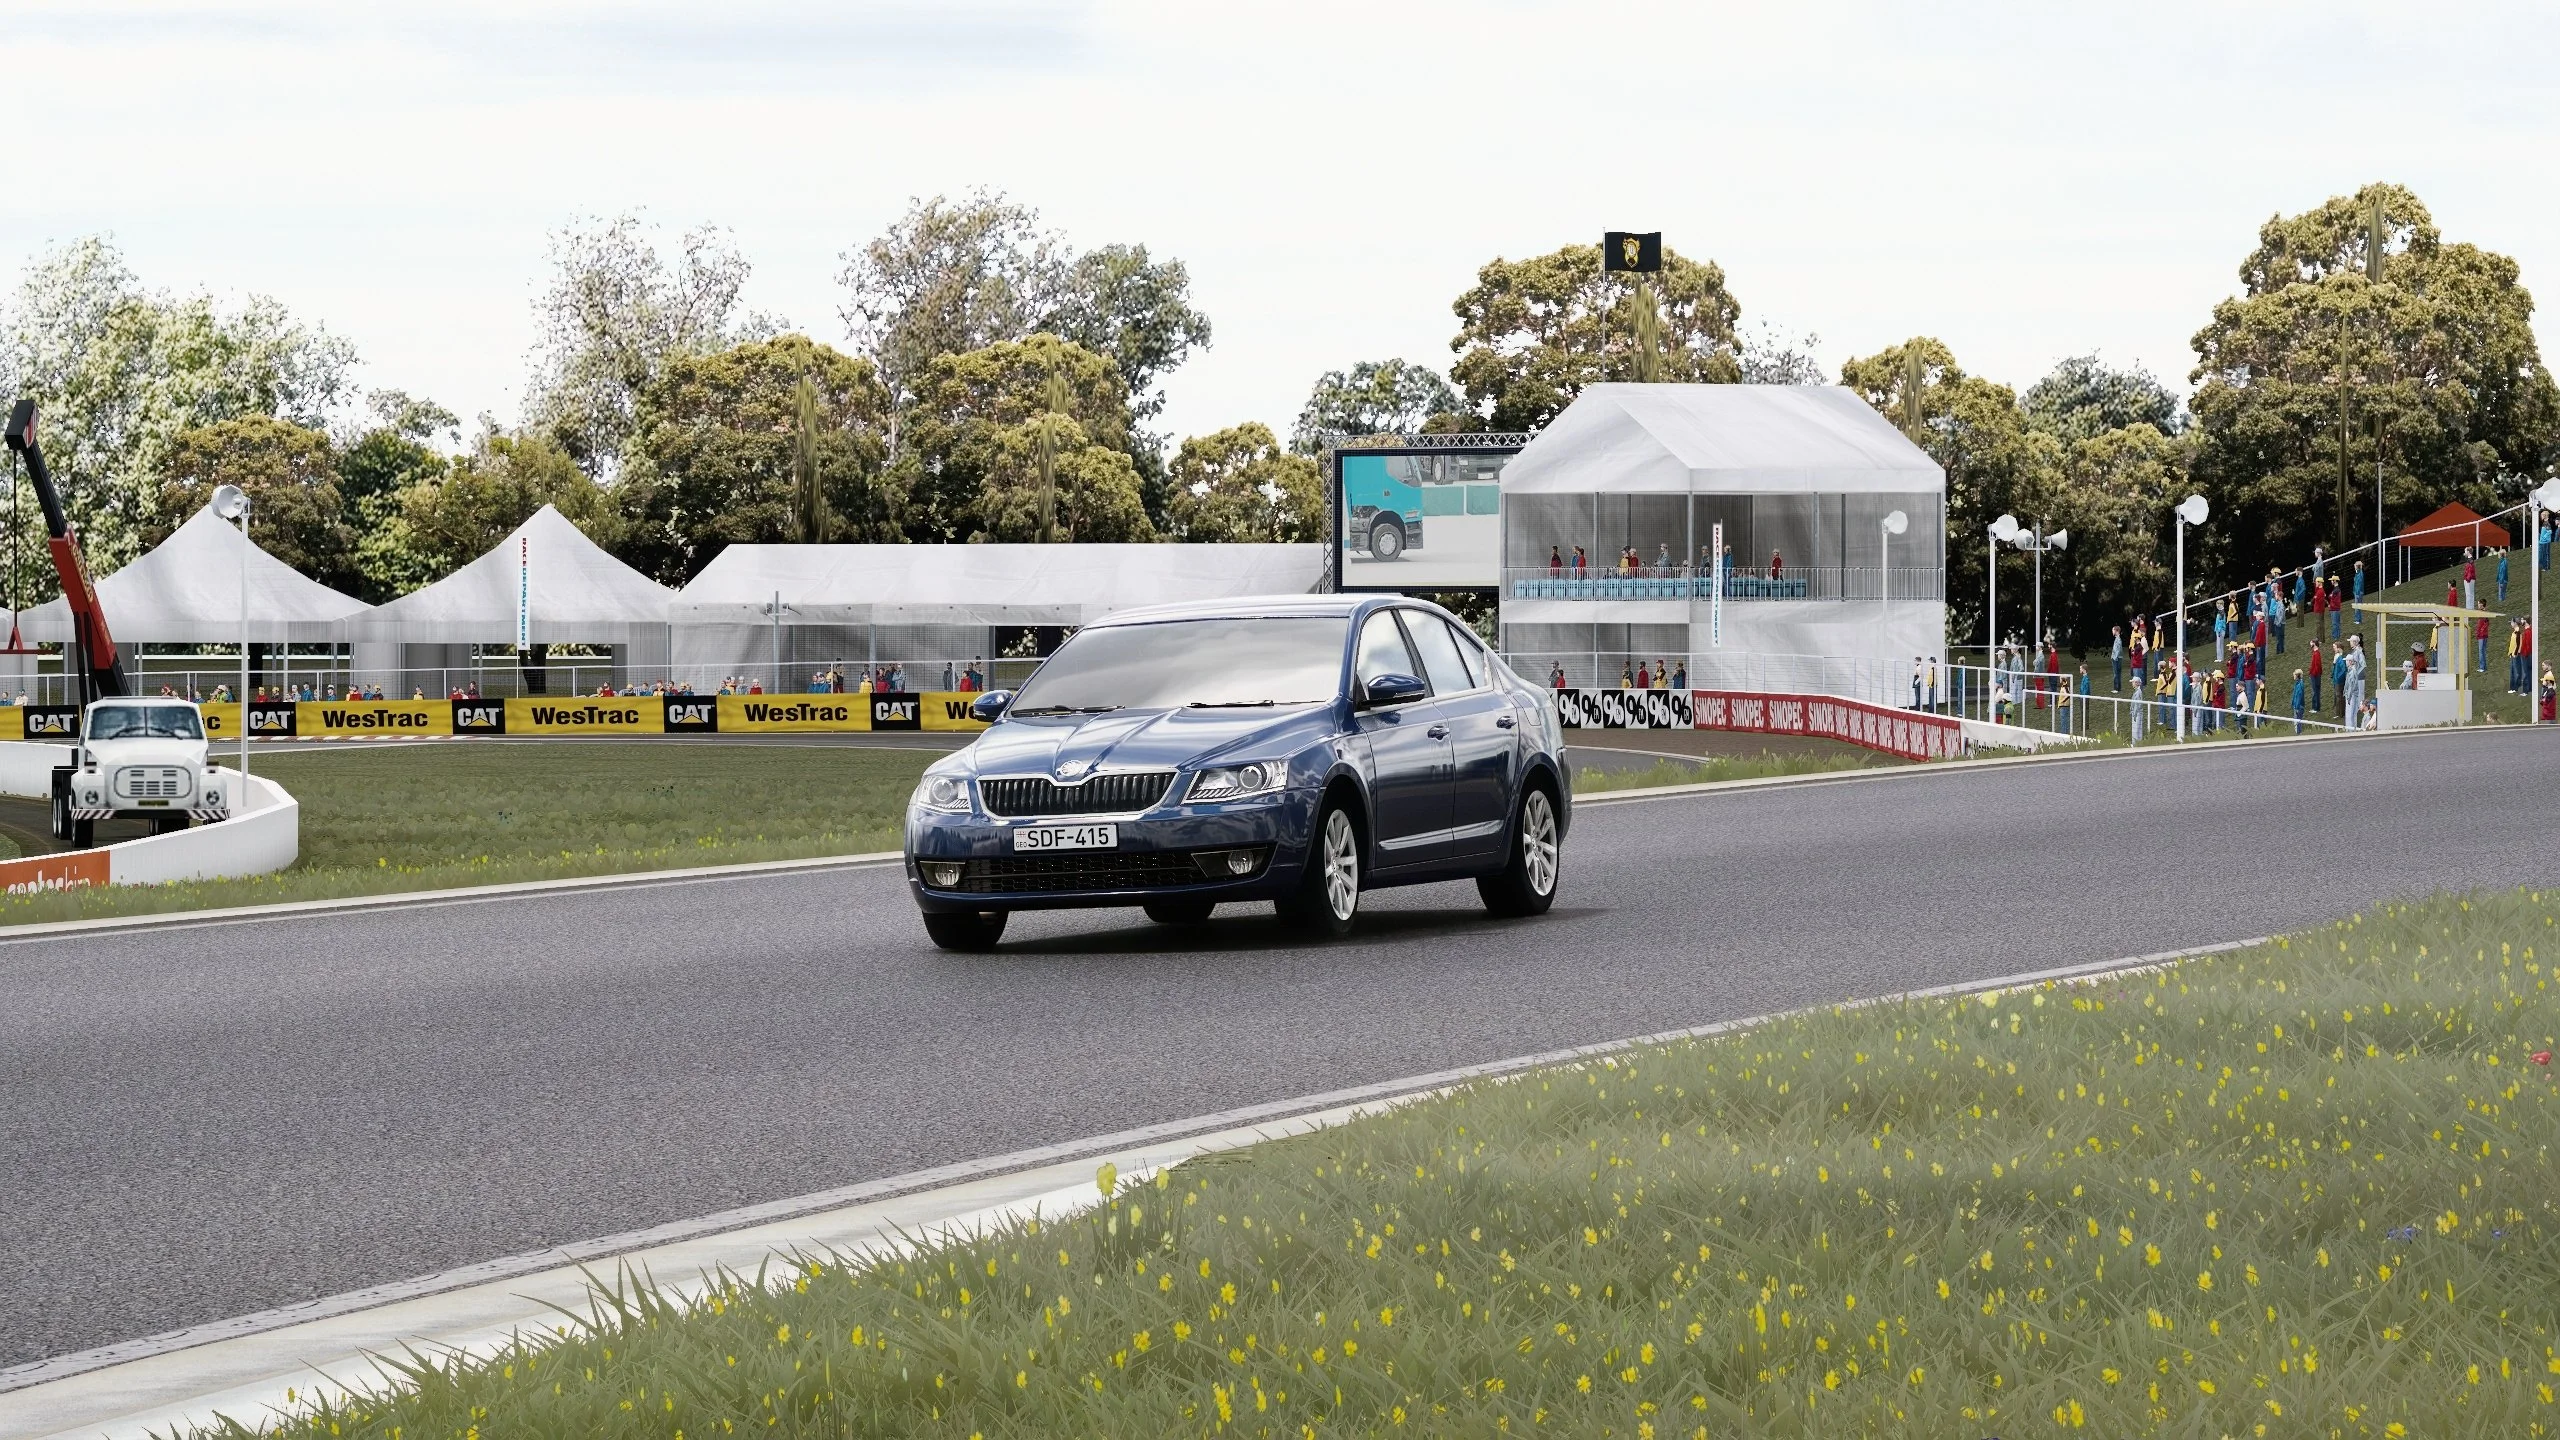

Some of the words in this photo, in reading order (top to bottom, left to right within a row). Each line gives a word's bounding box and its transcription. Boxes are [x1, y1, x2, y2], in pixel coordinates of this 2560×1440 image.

[250, 710, 290, 730] CAT
[322, 709, 428, 728] WesTrac
[457, 707, 499, 727] CAT
[531, 706, 639, 725] WesTrac
[668, 704, 711, 724] CAT
[744, 703, 848, 722] WesTrac
[875, 701, 915, 721] CAT
[1695, 697, 1727, 726] SINOPEC
[1731, 698, 1764, 729] SINOPEC
[1769, 700, 1803, 731] SINOPEC
[29, 714, 74, 733] CAT
[1028, 827, 1109, 848] SDF-415
